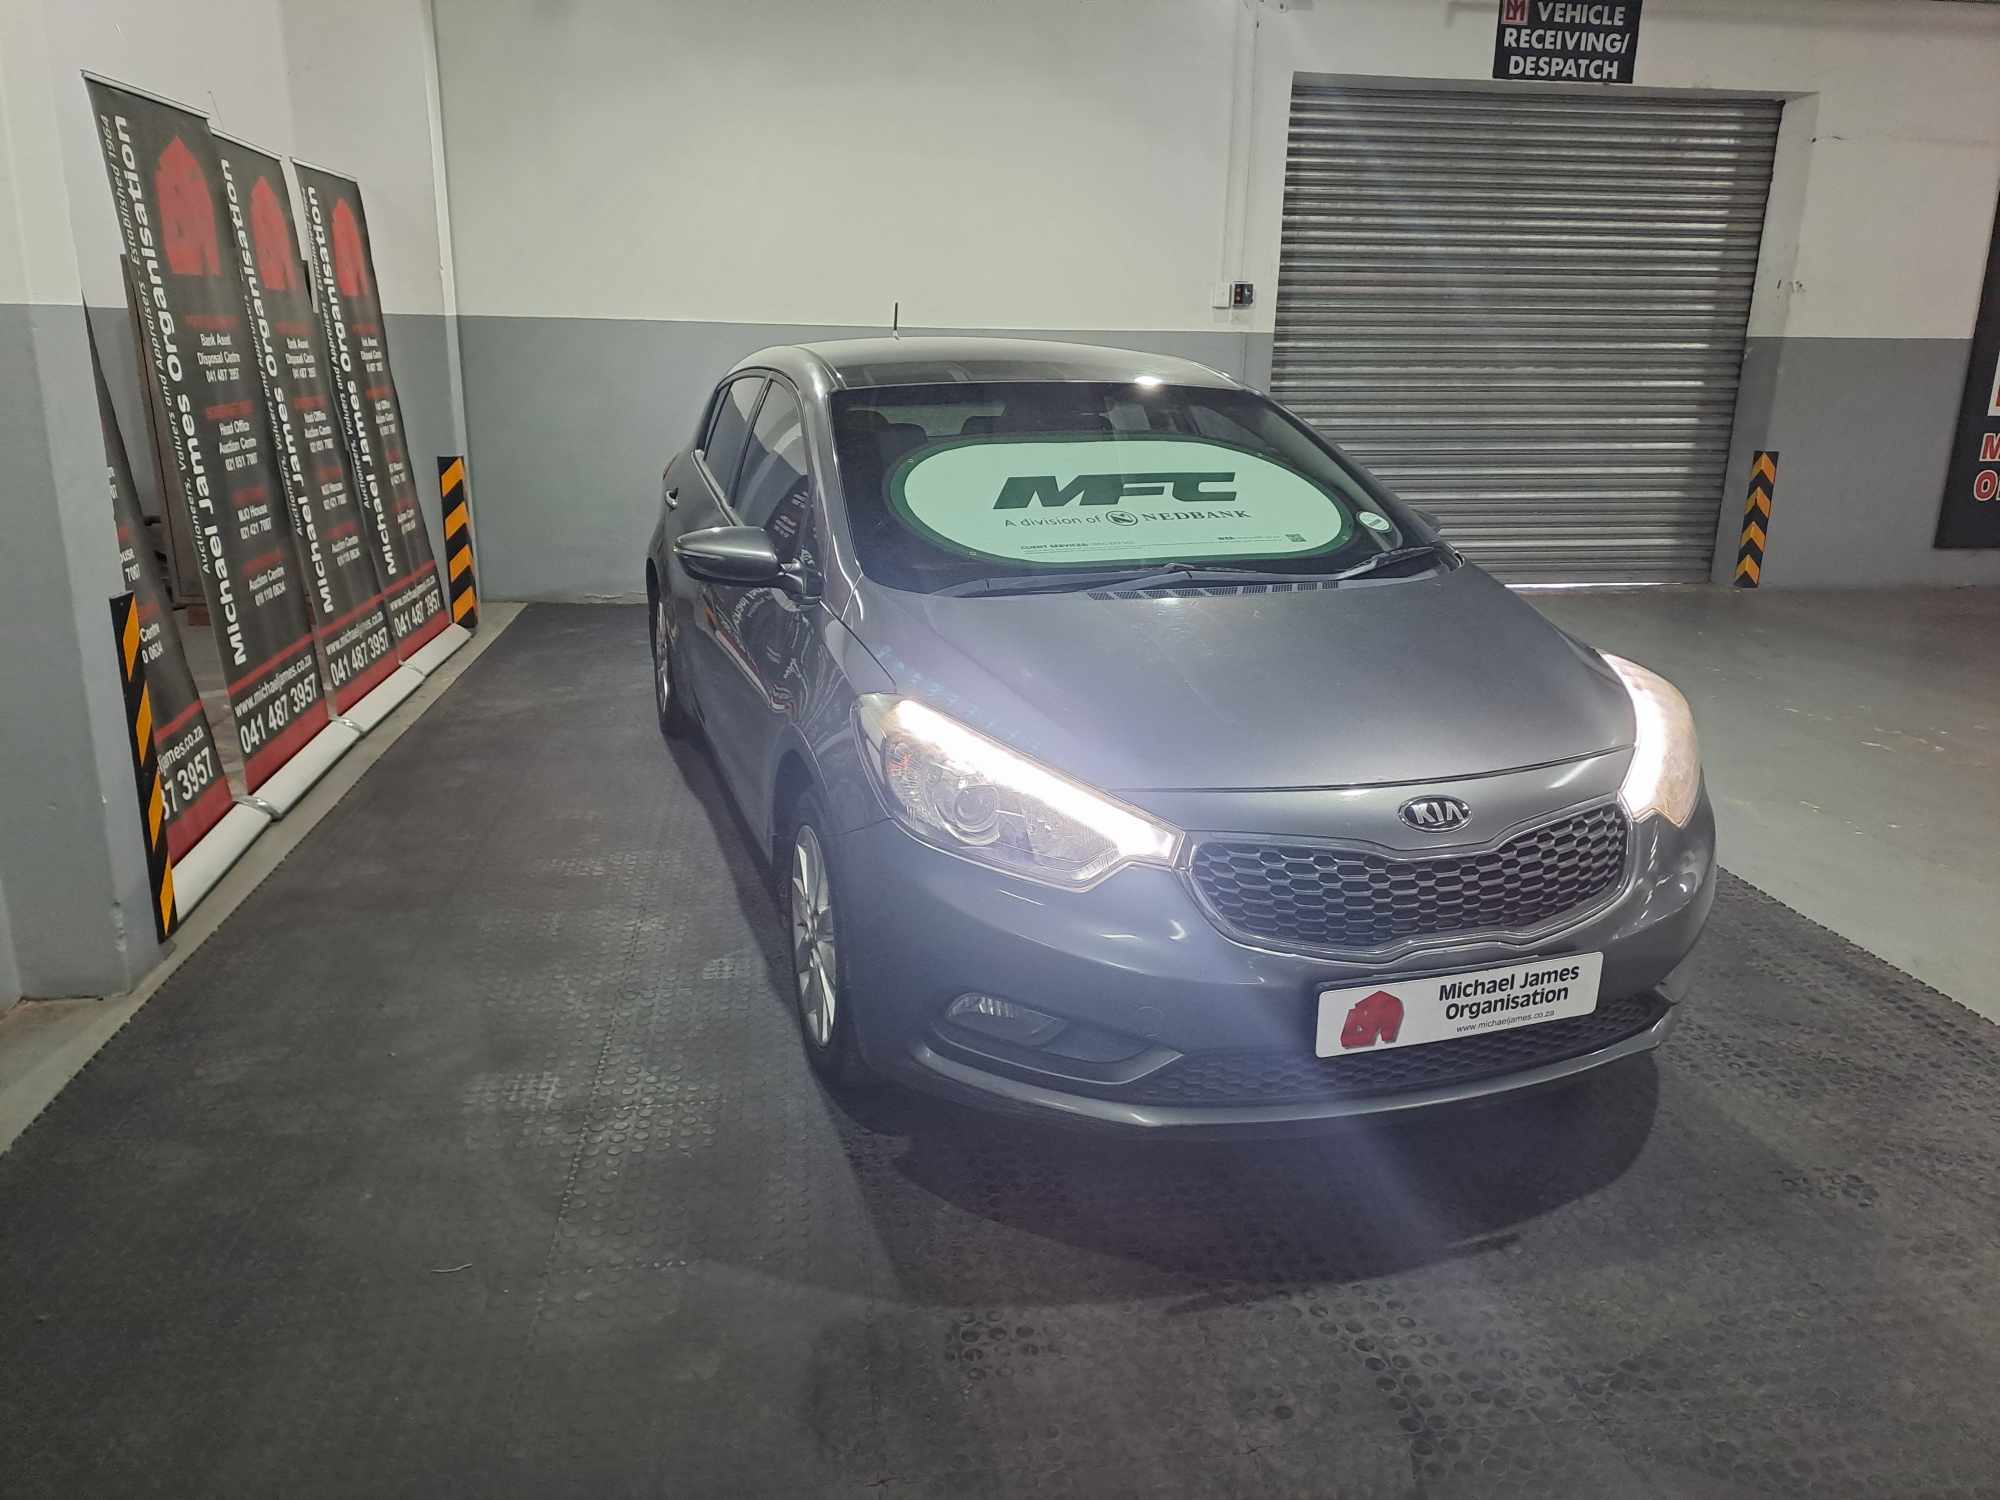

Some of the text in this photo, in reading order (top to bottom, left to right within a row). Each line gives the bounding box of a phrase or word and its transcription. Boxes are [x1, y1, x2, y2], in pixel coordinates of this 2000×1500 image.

[1537, 2, 1625, 26] VEHICLE
[1503, 28, 1631, 54] RECEIVING/
[1508, 55, 1619, 79] DESPATCH
[101, 113, 117, 158] 1964
[111, 163, 141, 266] Established
[221, 159, 278, 377] Organisation
[308, 186, 351, 373] Organisation
[138, 281, 166, 371] Appraisers
[197, 352, 223, 366] Disposal
[114, 115, 247, 667] Michael James Organisation
[158, 374, 173, 407] and
[168, 411, 187, 471] Valuers
[274, 387, 305, 487] James
[347, 381, 373, 467] James
[992, 471, 1237, 509] MFC
[1973, 469, 2000, 501] O
[365, 474, 397, 576] Michael
[1004, 509, 1252, 528] A division of NEDBANK
[297, 496, 334, 614] Michael
[394, 610, 413, 638] 041
[330, 627, 390, 687] 041 487 3957
[234, 654, 313, 718] www.michaeljames.co.za
[240, 673, 318, 755] 041 487 3957
[177, 746, 214, 801] 3957
[1410, 801, 1465, 824] KIA
[1439, 965, 1580, 1002] Michael James
[1445, 986, 1569, 1020] Organisation
[1456, 1010, 1555, 1033] www.michaeljames.co.za
